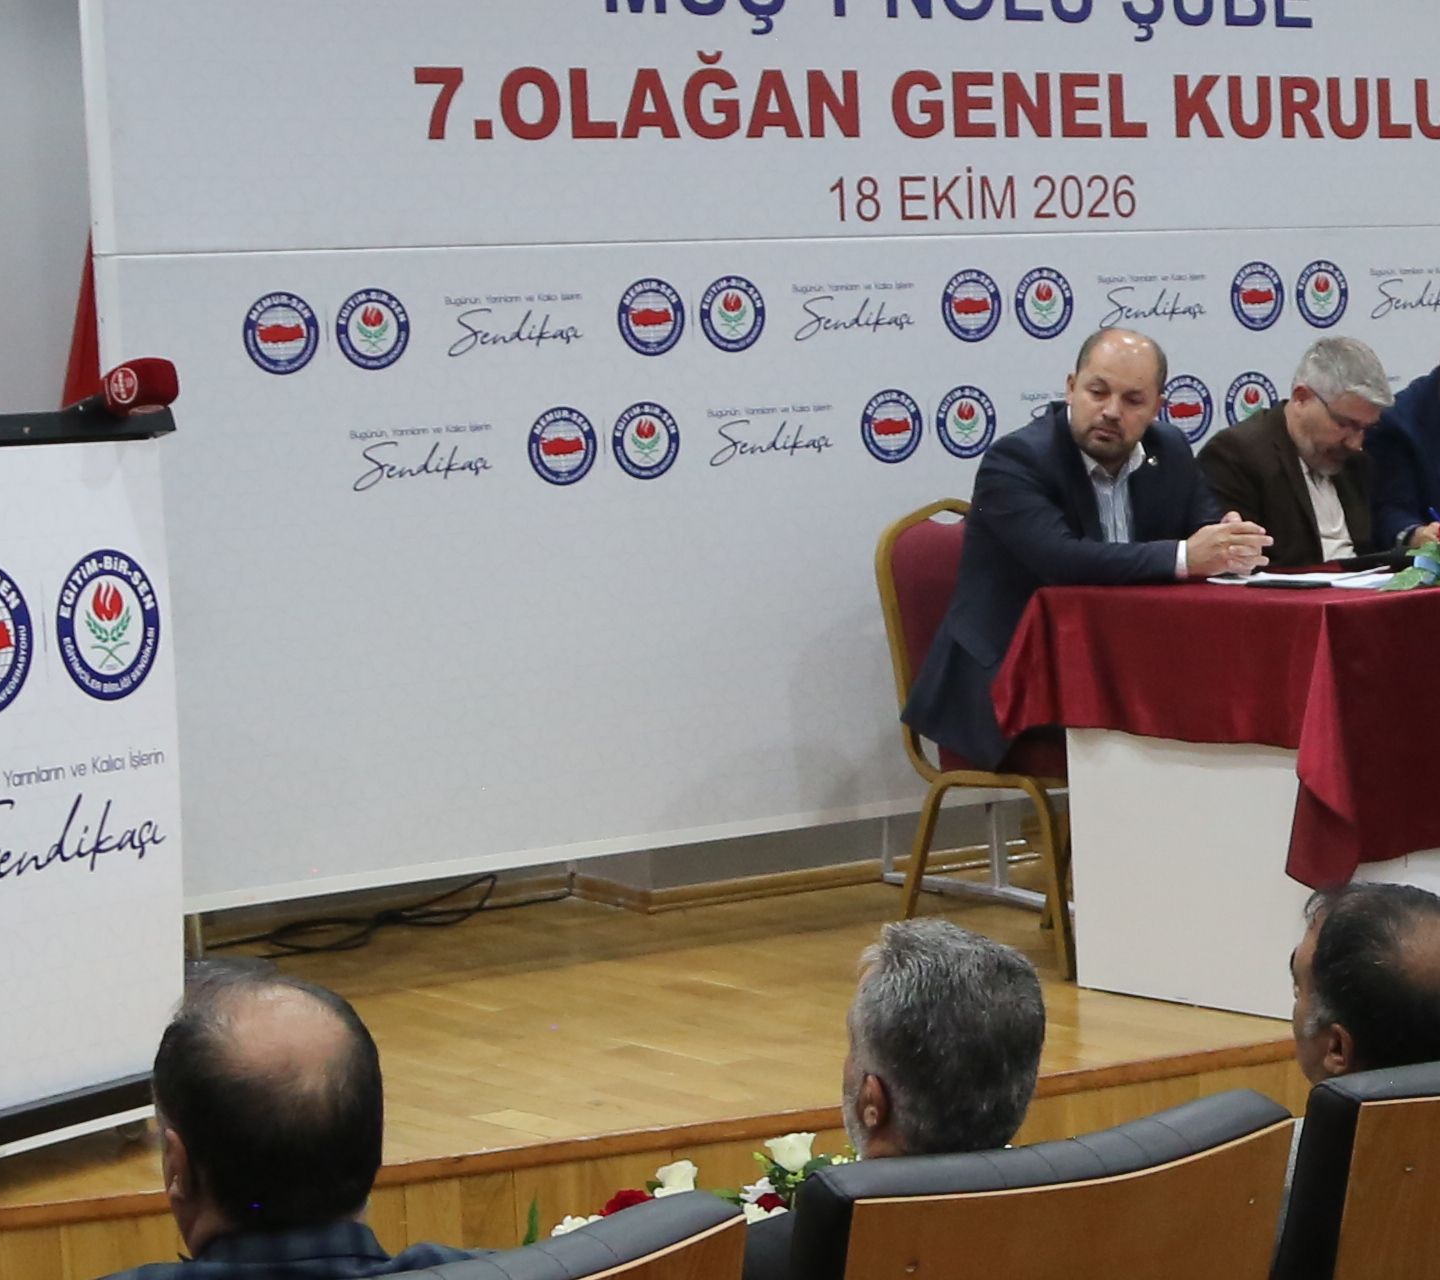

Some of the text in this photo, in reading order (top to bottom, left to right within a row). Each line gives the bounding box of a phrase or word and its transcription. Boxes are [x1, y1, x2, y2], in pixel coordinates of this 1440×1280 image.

[414, 49, 860, 141] 7.OLAĞAN
[891, 70, 1147, 139] GENEL
[829, 166, 1137, 222] 18 EKİM 2026
[70, 763, 87, 777] ve
